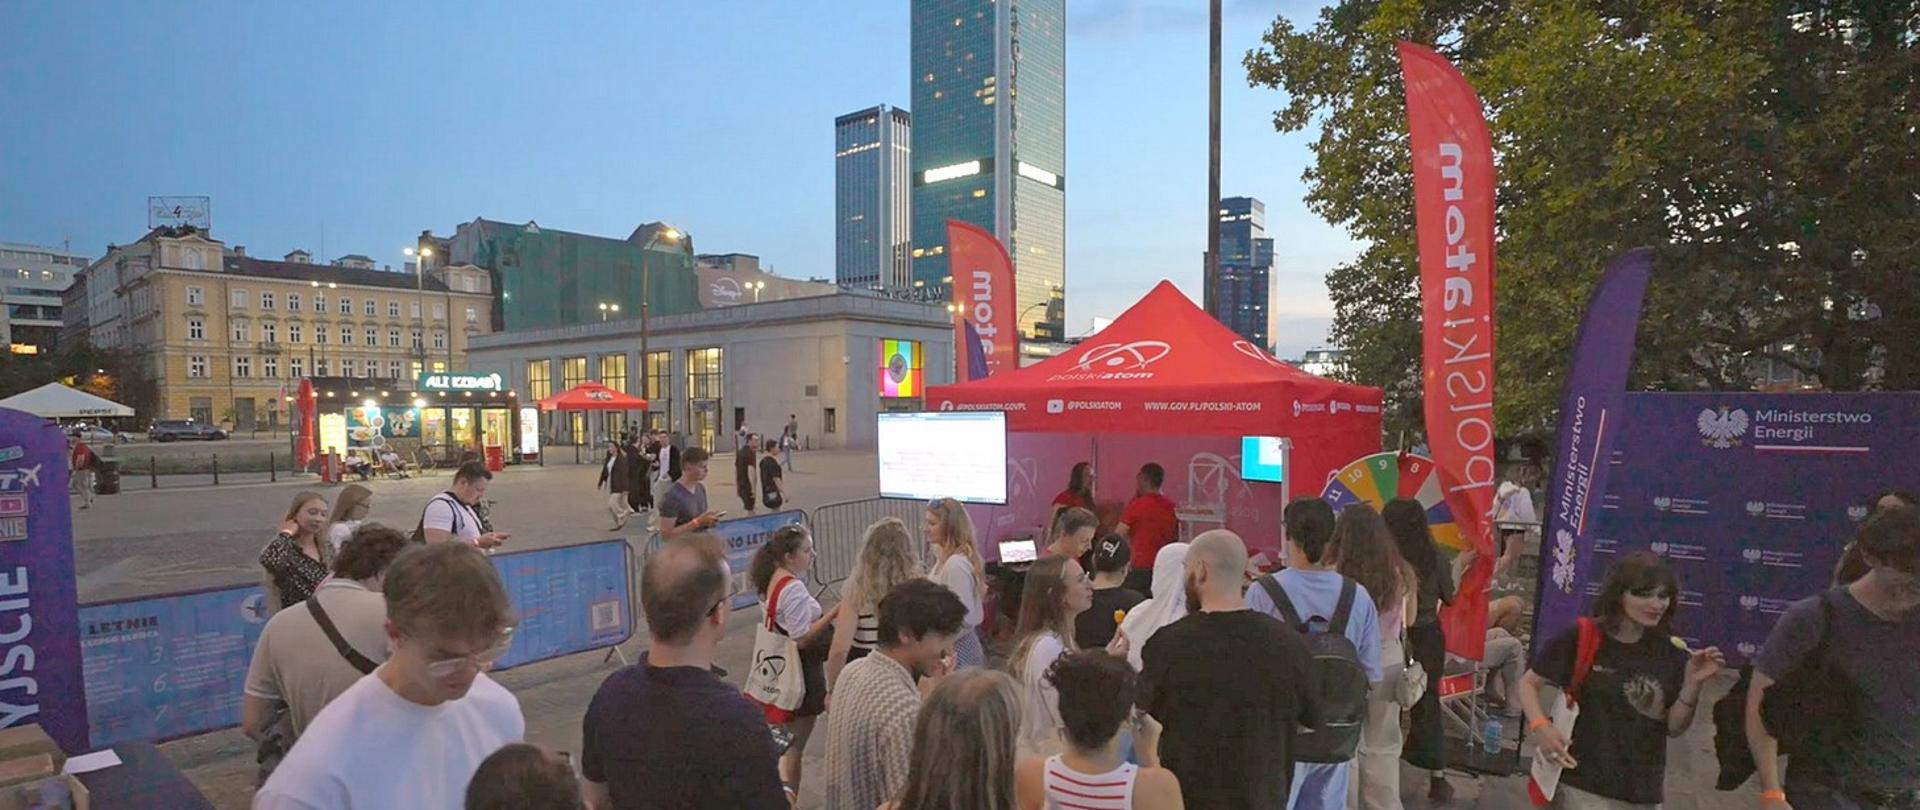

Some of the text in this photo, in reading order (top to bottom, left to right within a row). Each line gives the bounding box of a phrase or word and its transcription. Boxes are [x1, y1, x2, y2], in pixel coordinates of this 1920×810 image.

[1439, 143, 1494, 492] polskiatom
[425, 376, 495, 389] ALI KEBAB
[1047, 371, 1153, 382] polskiatom
[1067, 401, 1121, 410] @POLSKIATOM
[1144, 401, 1262, 411] WWW.GOV.PL/POLSKI-ATOM
[1755, 409, 1872, 424] Ministerstwo
[1754, 425, 1814, 441] Energii
[1379, 459, 1388, 470] 9
[1560, 396, 1586, 521] Ministerstwo
[1410, 463, 1420, 473] 8
[1348, 468, 1363, 484] 10
[1328, 489, 1343, 502] 11
[1570, 462, 1588, 528] Energii
[88, 616, 159, 635] LETNIE
[153, 673, 167, 692] 6
